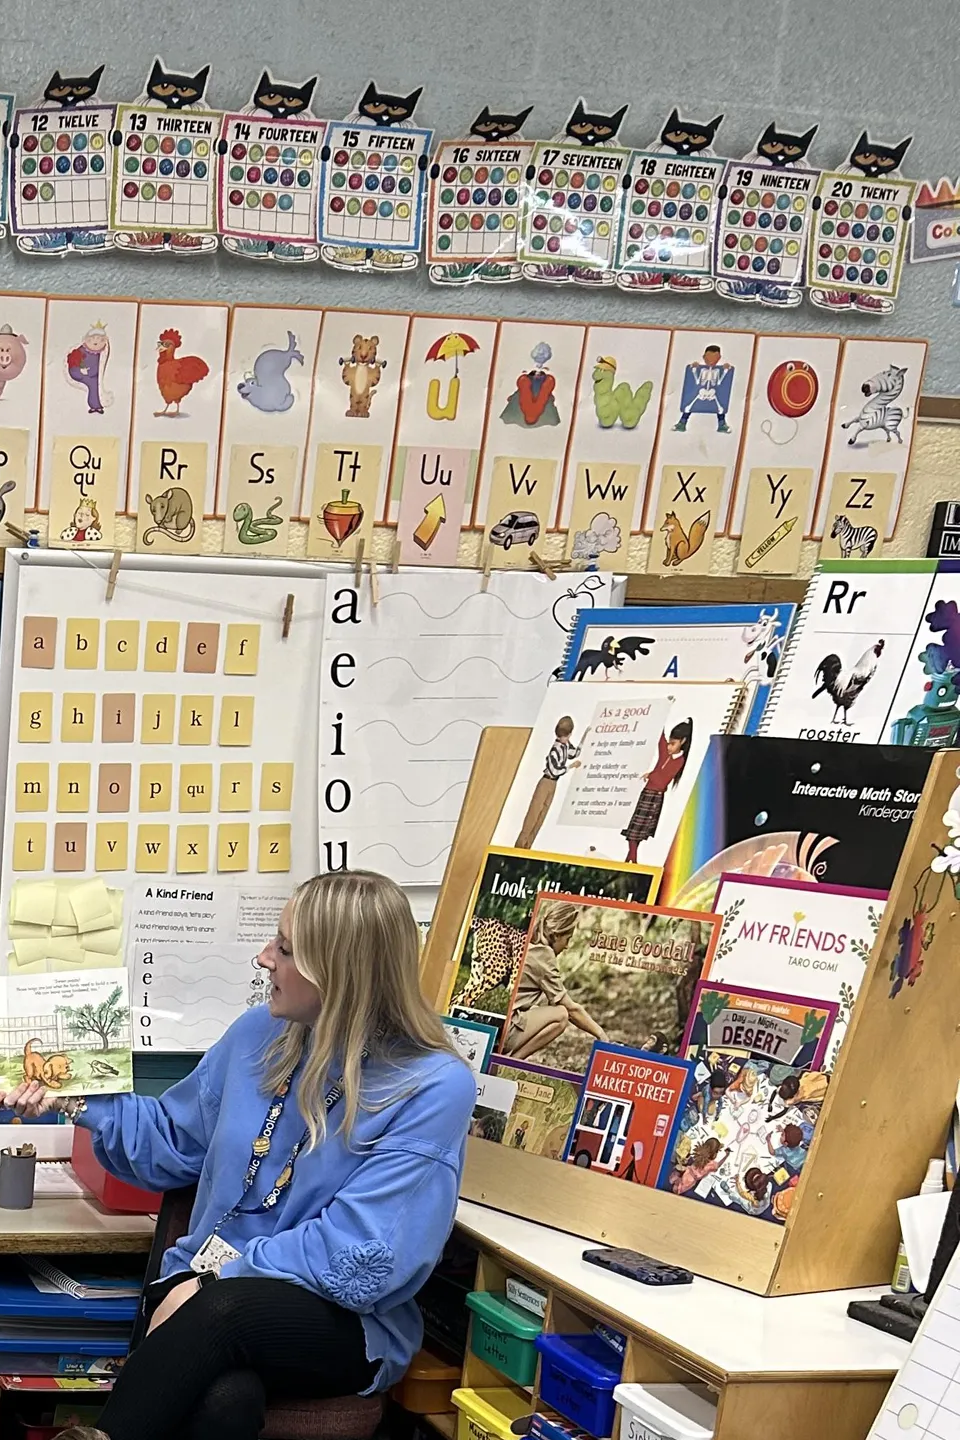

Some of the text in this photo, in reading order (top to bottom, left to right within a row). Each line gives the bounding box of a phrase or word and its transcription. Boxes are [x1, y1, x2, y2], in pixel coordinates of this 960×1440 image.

[31, 115, 99, 131] 12 TWELVE
[130, 114, 212, 134] 13 THIRTEEN
[234, 123, 317, 143] 14 FOURTEEN
[342, 130, 415, 150] 15 FIFTEEN
[452, 148, 520, 163] 16 SIXTEEN
[542, 150, 623, 170] 17 SEVENTEEN
[640, 159, 716, 179] 18 EIGHTEEN
[737, 169, 811, 191] 19 NINETEEN
[832, 182, 899, 200] 20 TWENTY
[70, 445, 101, 471] Qu
[160, 448, 188, 480] Rr
[248, 452, 274, 484] Ss
[334, 451, 361, 482] Tt
[421, 455, 452, 486] Uu
[509, 463, 537, 496] Vv
[73, 473, 95, 497] qu
[585, 469, 628, 501] Ww
[673, 472, 706, 503] Xx
[767, 474, 792, 518] Yy
[845, 479, 874, 509] Zz
[756, 535, 775, 555] YELLOW
[331, 588, 361, 624] a
[823, 581, 867, 614] Rr
[331, 652, 356, 687] e
[663, 656, 679, 678] A
[600, 707, 613, 717] As
[623, 704, 651, 719] good
[331, 713, 346, 756] i
[595, 721, 638, 733] citizen, I
[799, 728, 860, 742] rooster
[325, 778, 351, 812] o
[792, 781, 921, 803] Interactive Math Stor
[323, 842, 348, 872] u
[146, 888, 213, 900] A Kind Friend
[590, 930, 696, 962] Jane Goodall
[738, 920, 847, 953] MY FRIENDS
[590, 952, 623, 965] and the
[788, 956, 838, 972] TARO GOMI
[732, 1014, 778, 1030] Day Night
[722, 1026, 787, 1055] DESERT
[603, 1060, 670, 1084] LAST STOP ON
[593, 1074, 675, 1104] MARKET STREET
